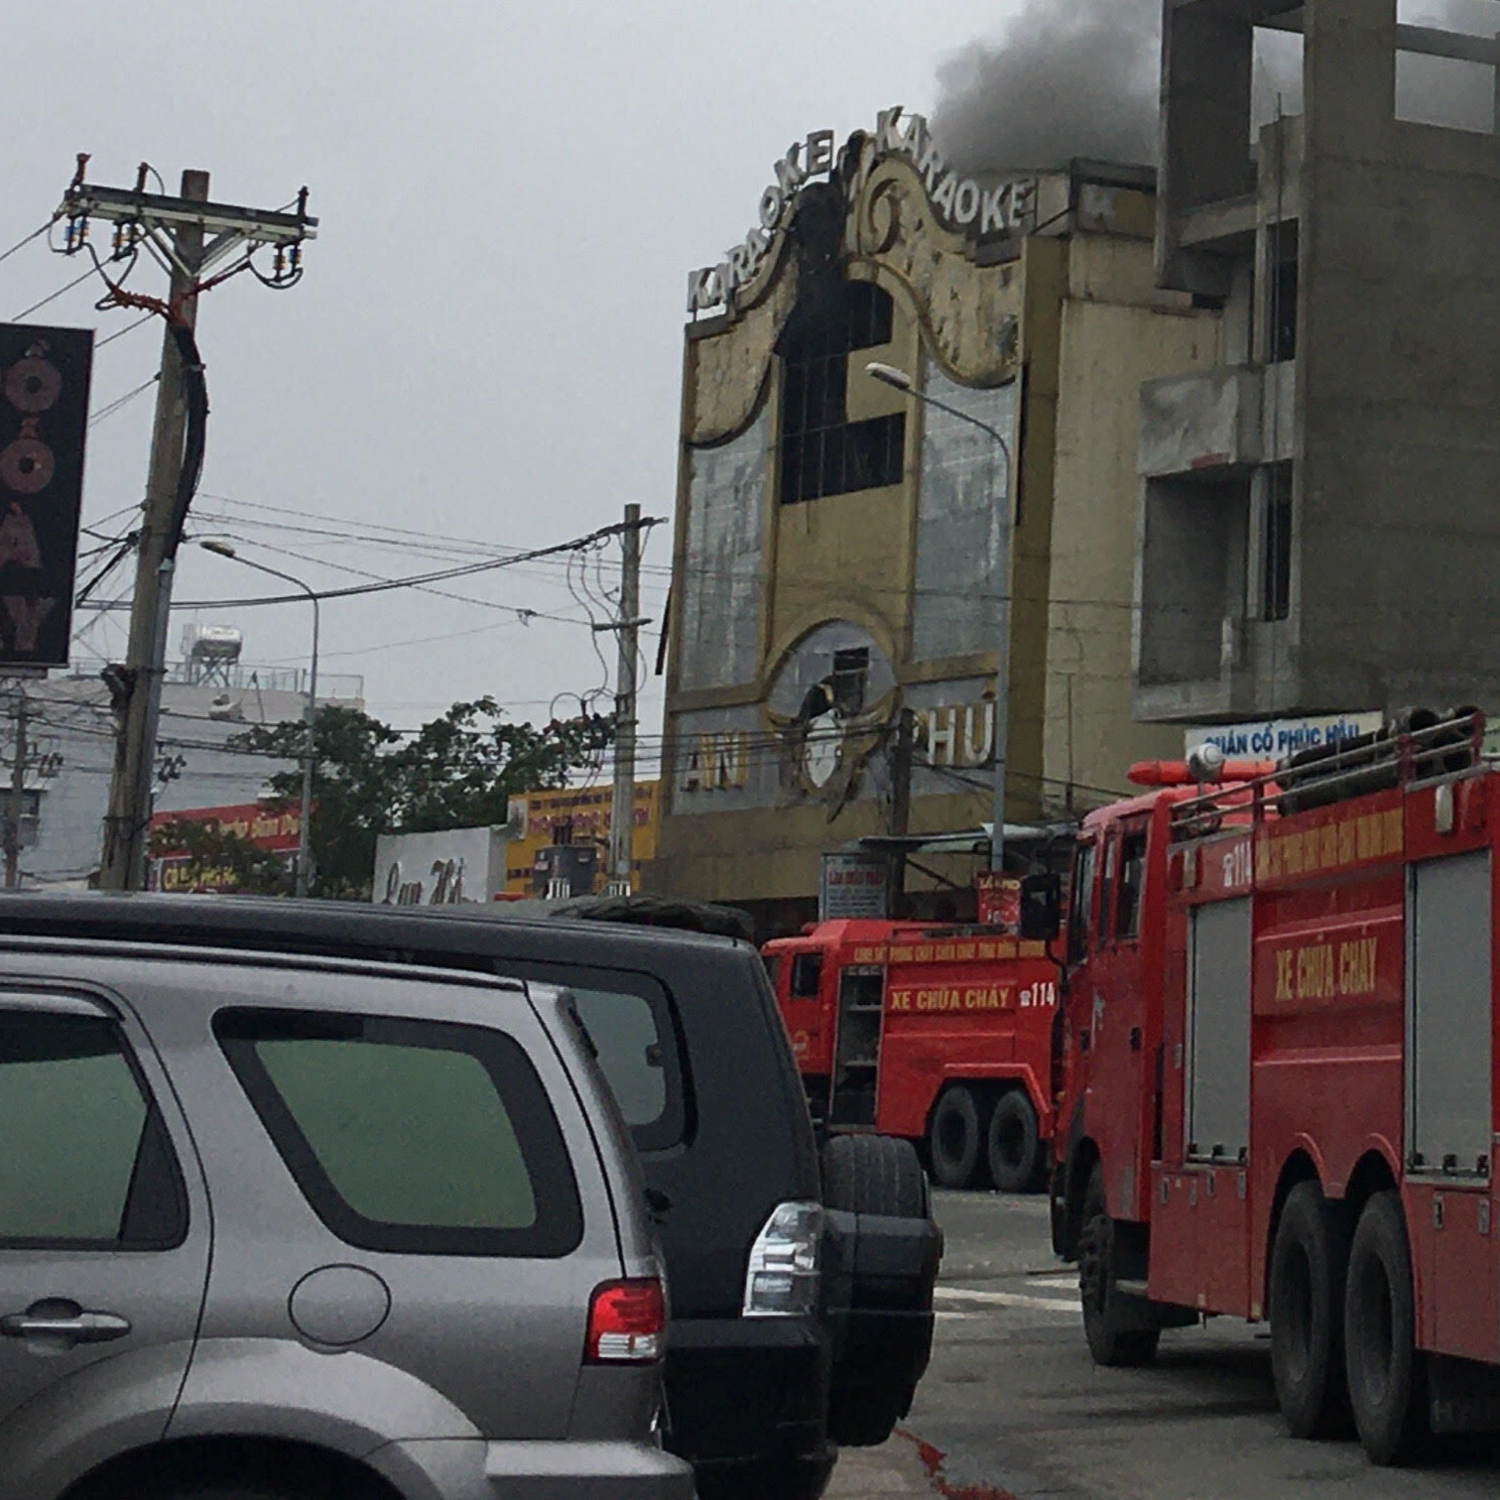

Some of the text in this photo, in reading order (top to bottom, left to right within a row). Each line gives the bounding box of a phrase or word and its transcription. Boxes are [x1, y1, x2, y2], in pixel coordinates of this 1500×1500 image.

[876, 106, 1038, 234] KARAOKE
[687, 129, 836, 313] KARAOKE
[891, 991, 912, 1010] XE
[1032, 981, 1056, 1007] 114
[1275, 949, 1294, 1000] XE
